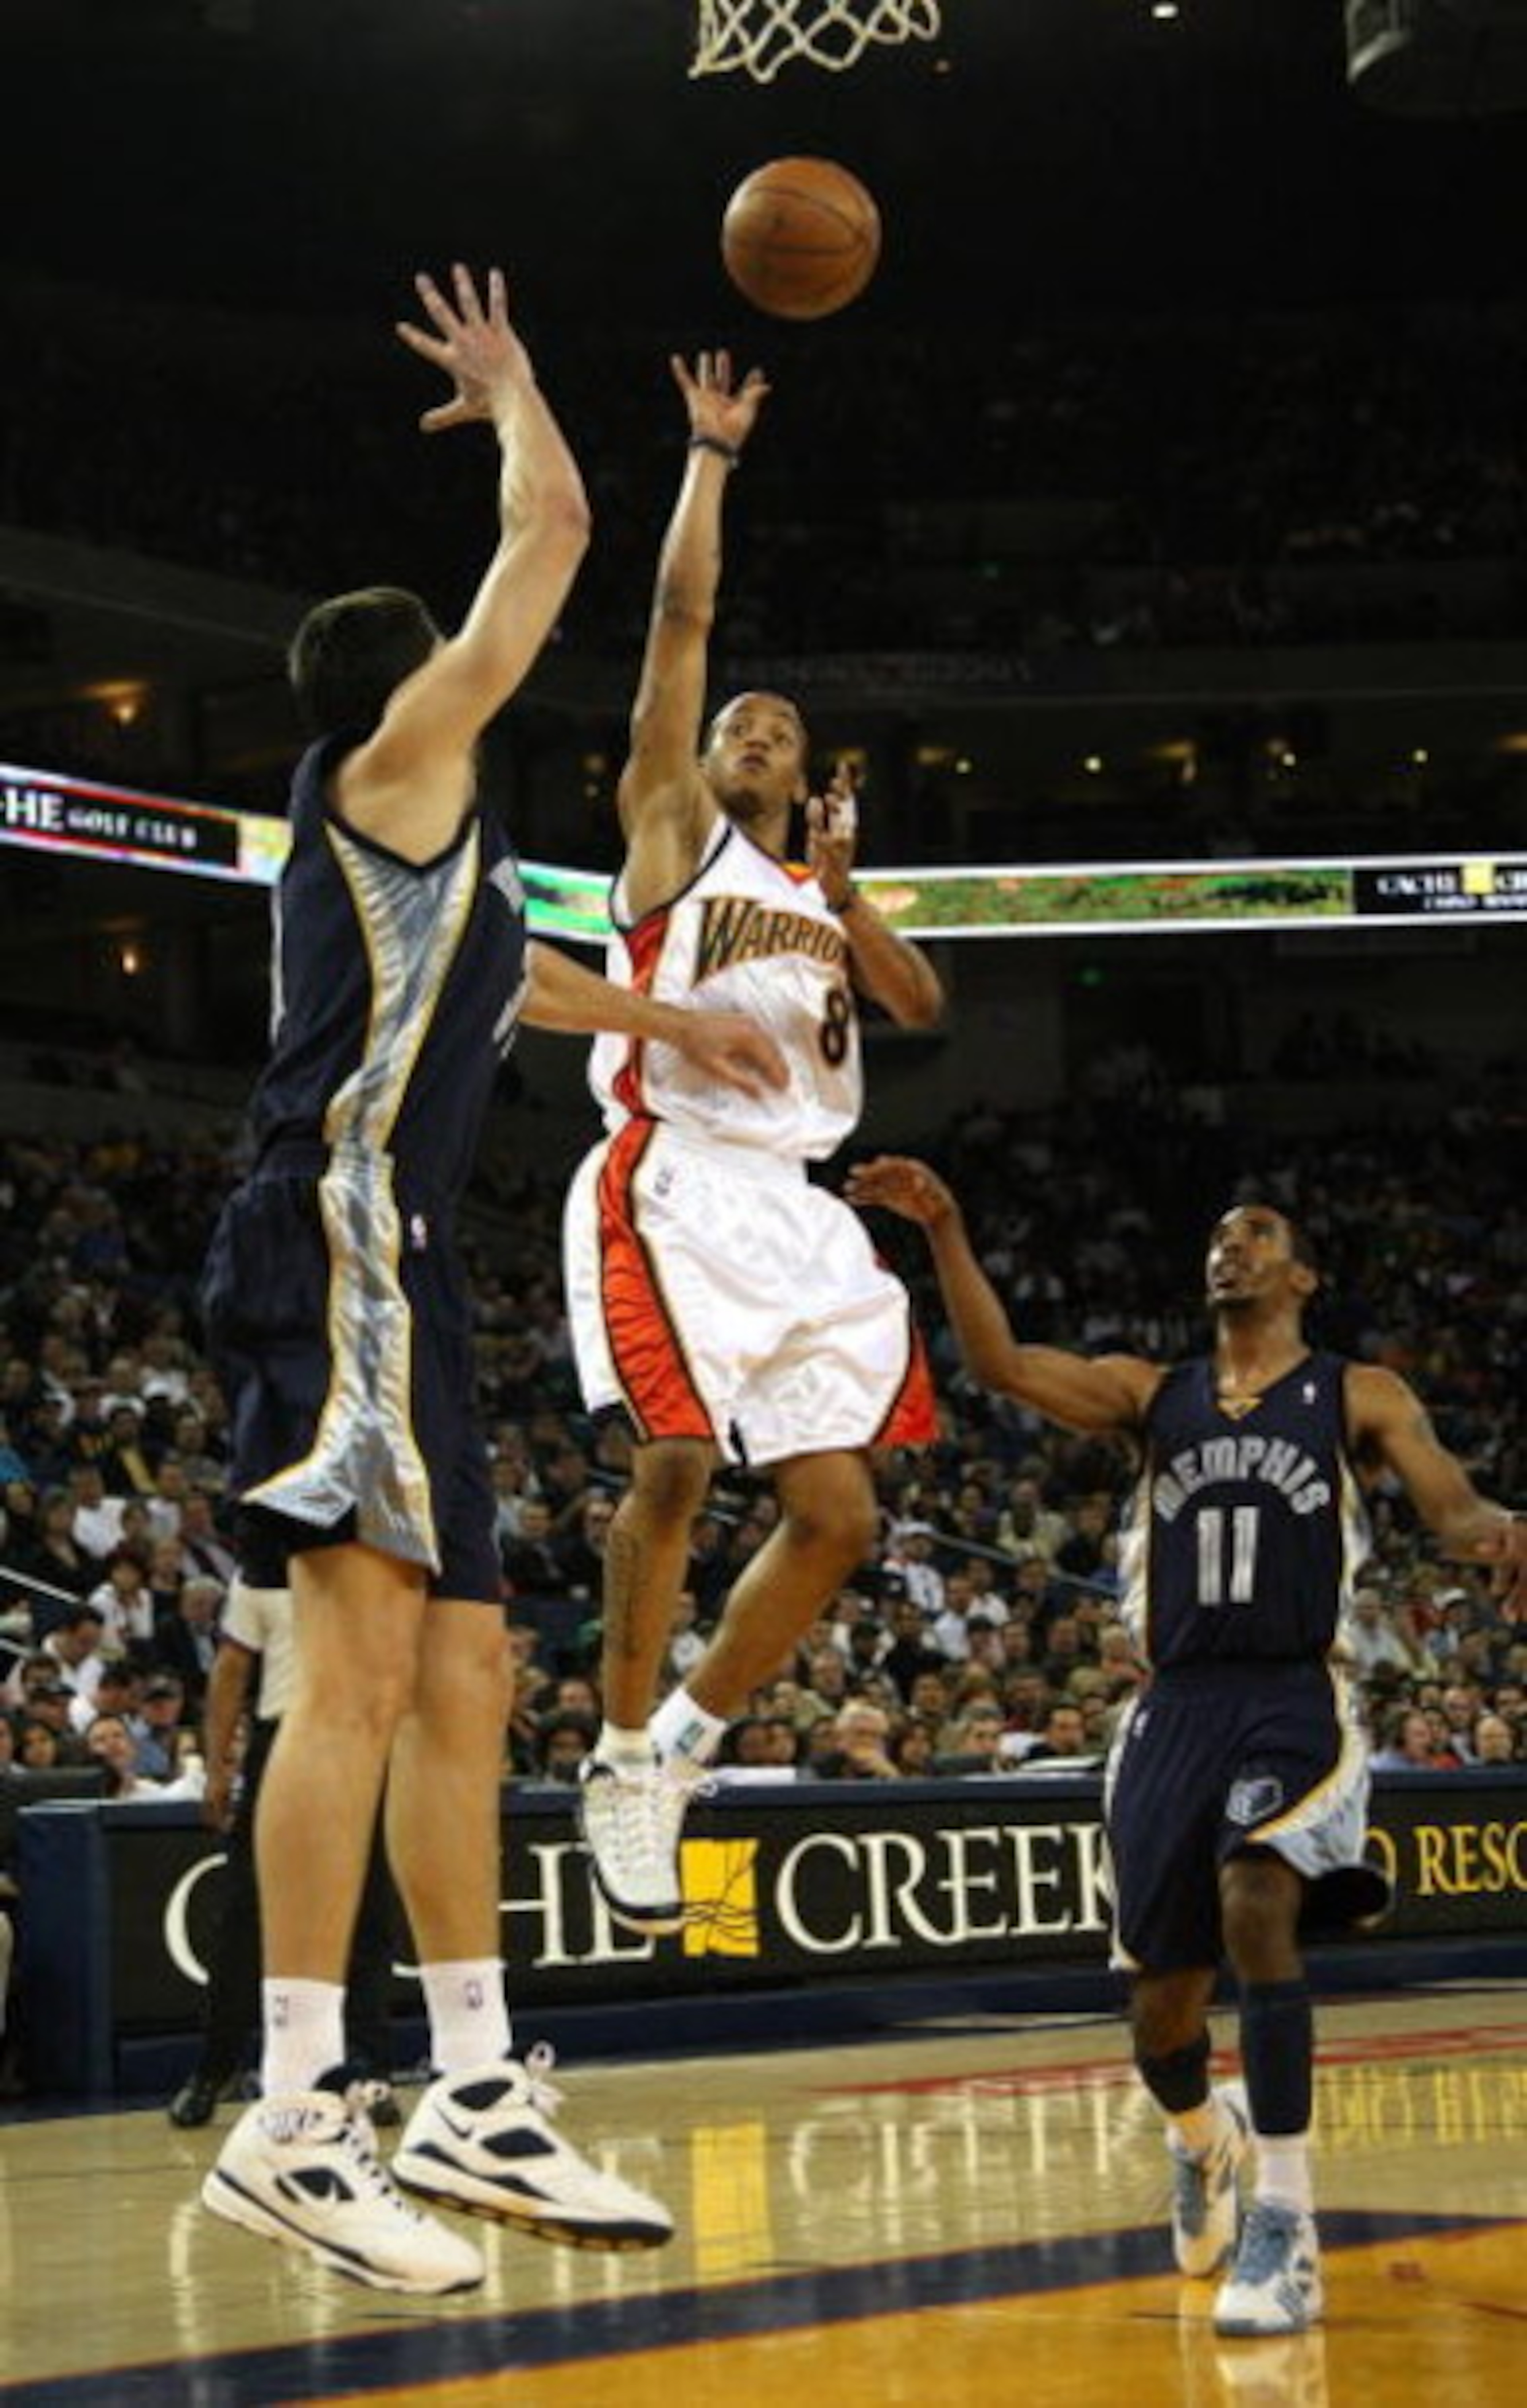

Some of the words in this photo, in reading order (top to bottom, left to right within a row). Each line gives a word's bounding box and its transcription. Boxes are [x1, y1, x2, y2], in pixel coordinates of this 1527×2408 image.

[820, 989, 850, 1067] 8
[1152, 1434, 1331, 1523] MEMPHIS
[1197, 1505, 1261, 1605] 11
